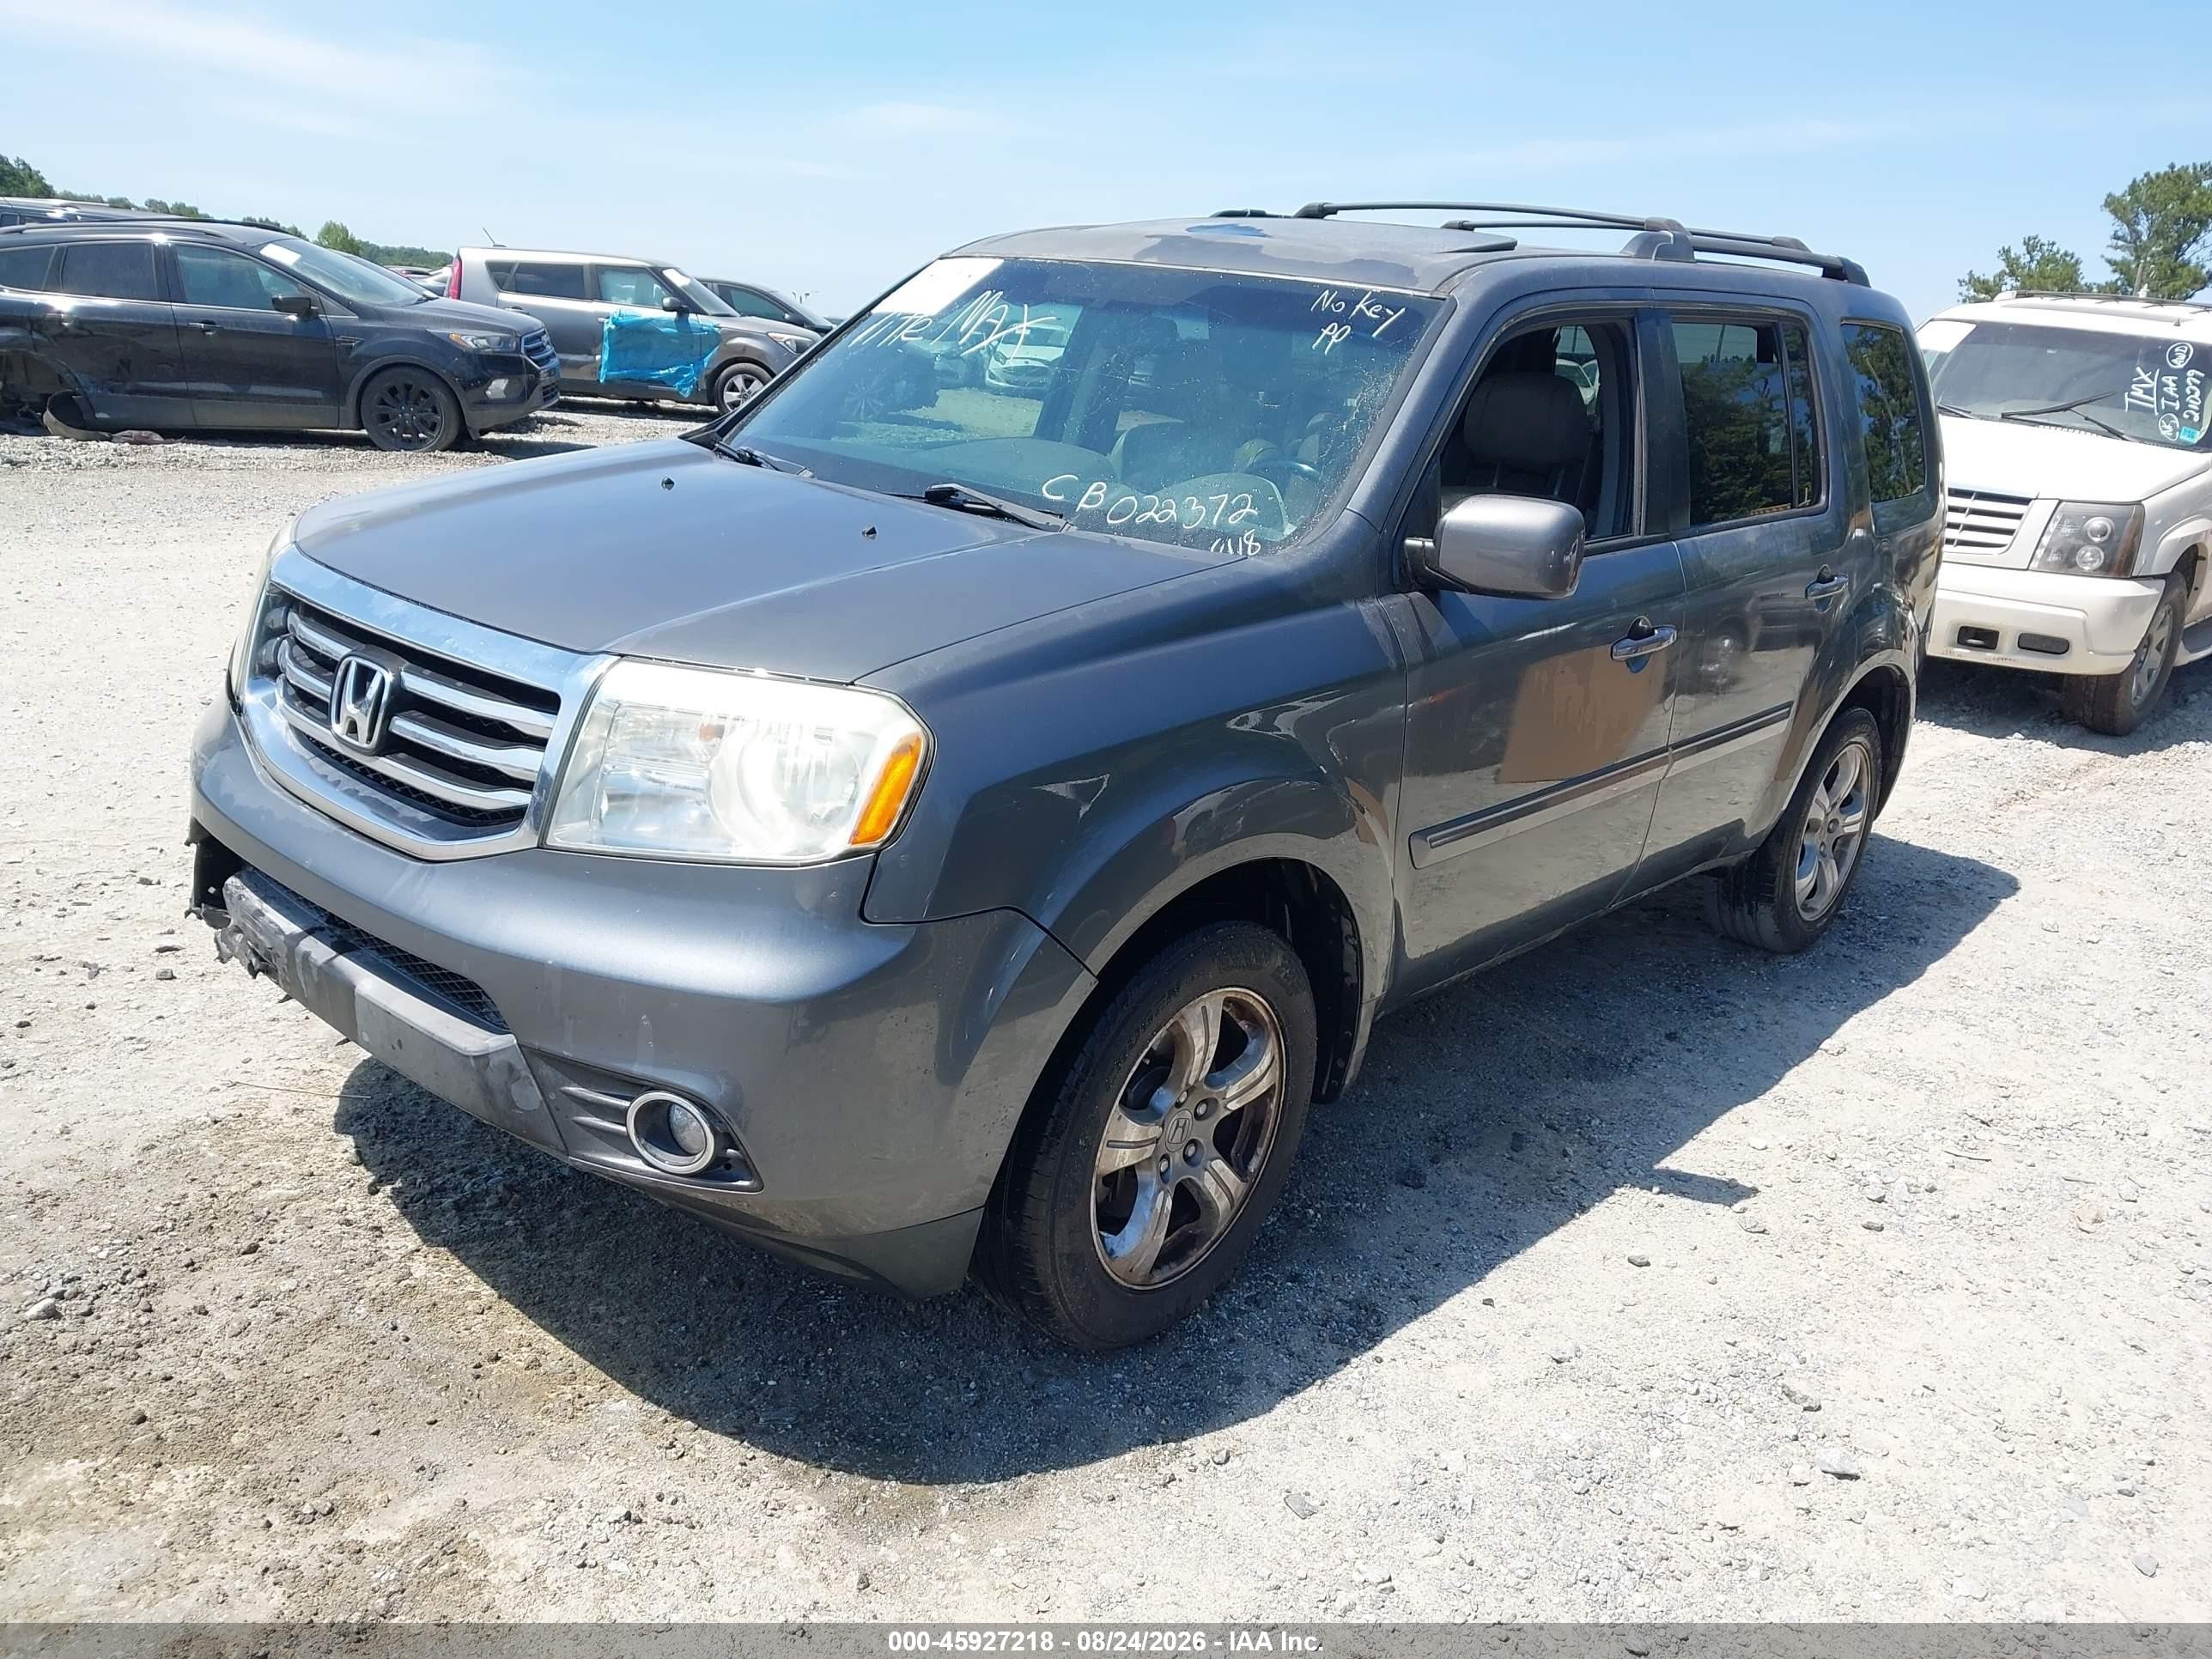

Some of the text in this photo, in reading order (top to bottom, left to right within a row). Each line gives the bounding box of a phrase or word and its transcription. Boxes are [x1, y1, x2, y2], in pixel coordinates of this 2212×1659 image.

[1310, 289, 1407, 337] No Key
[2124, 366, 2154, 413] TMX
[2161, 375, 2180, 410] IAA
